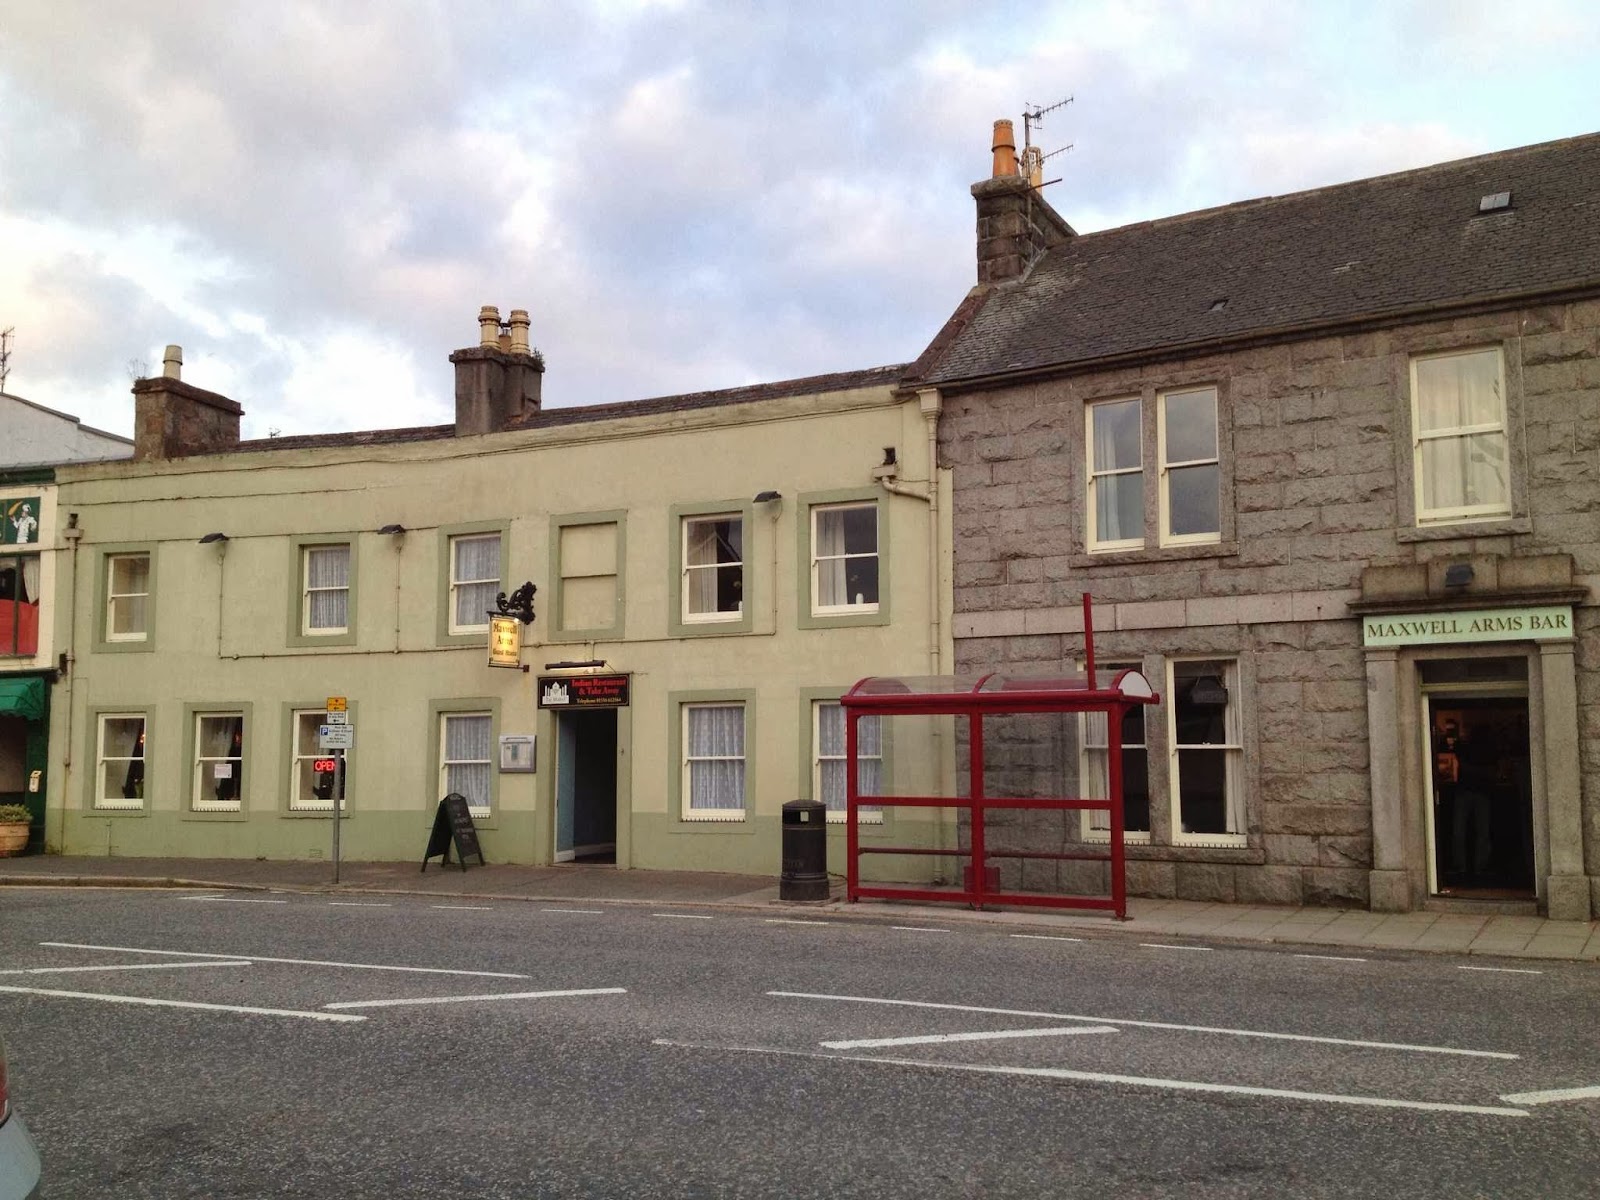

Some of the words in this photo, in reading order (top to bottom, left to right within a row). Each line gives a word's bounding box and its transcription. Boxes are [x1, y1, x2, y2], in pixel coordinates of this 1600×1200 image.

[1367, 620, 1463, 638] MAXWELL
[1469, 616, 1523, 633] ARMS
[1530, 614, 1568, 630] BAR
